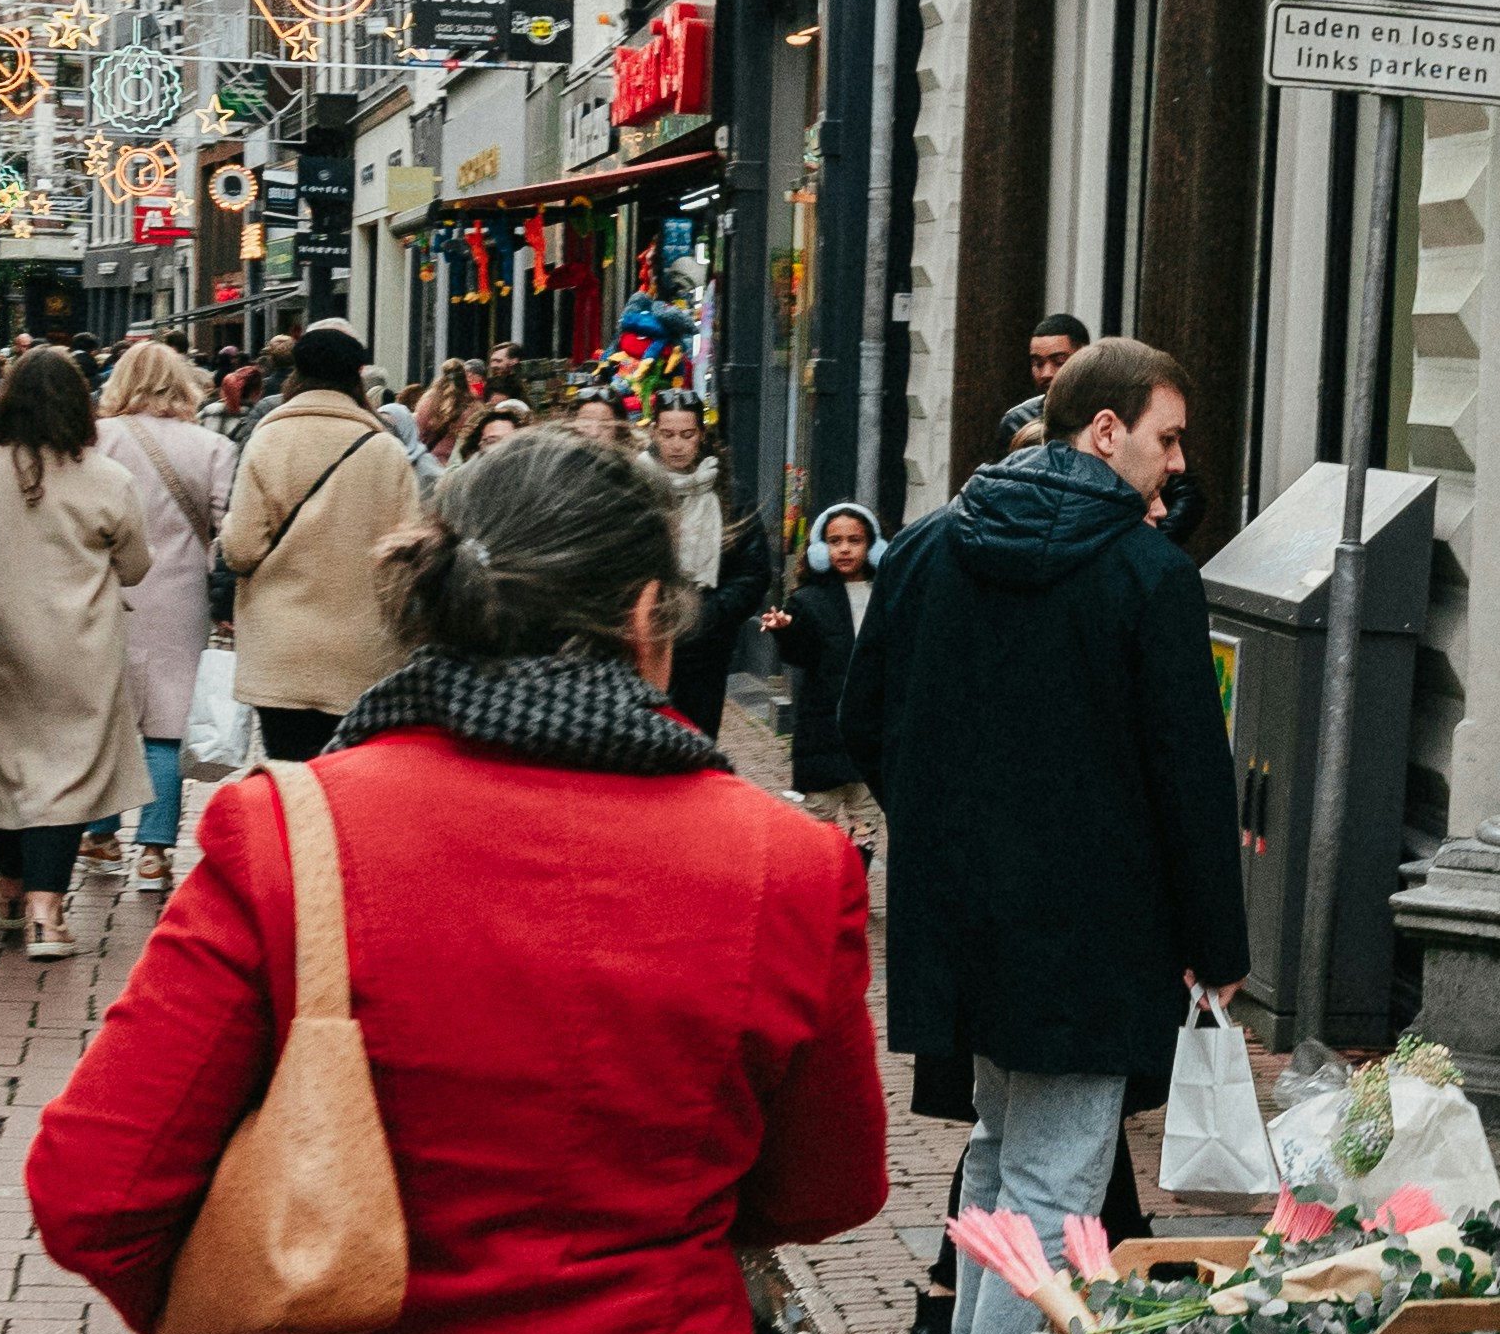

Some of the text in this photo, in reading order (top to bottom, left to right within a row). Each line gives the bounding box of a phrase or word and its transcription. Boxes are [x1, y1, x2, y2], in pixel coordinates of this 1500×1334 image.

[1284, 14, 1360, 40] Laden
[1371, 26, 1401, 44] en
[1296, 46, 1488, 84] links parkeren
